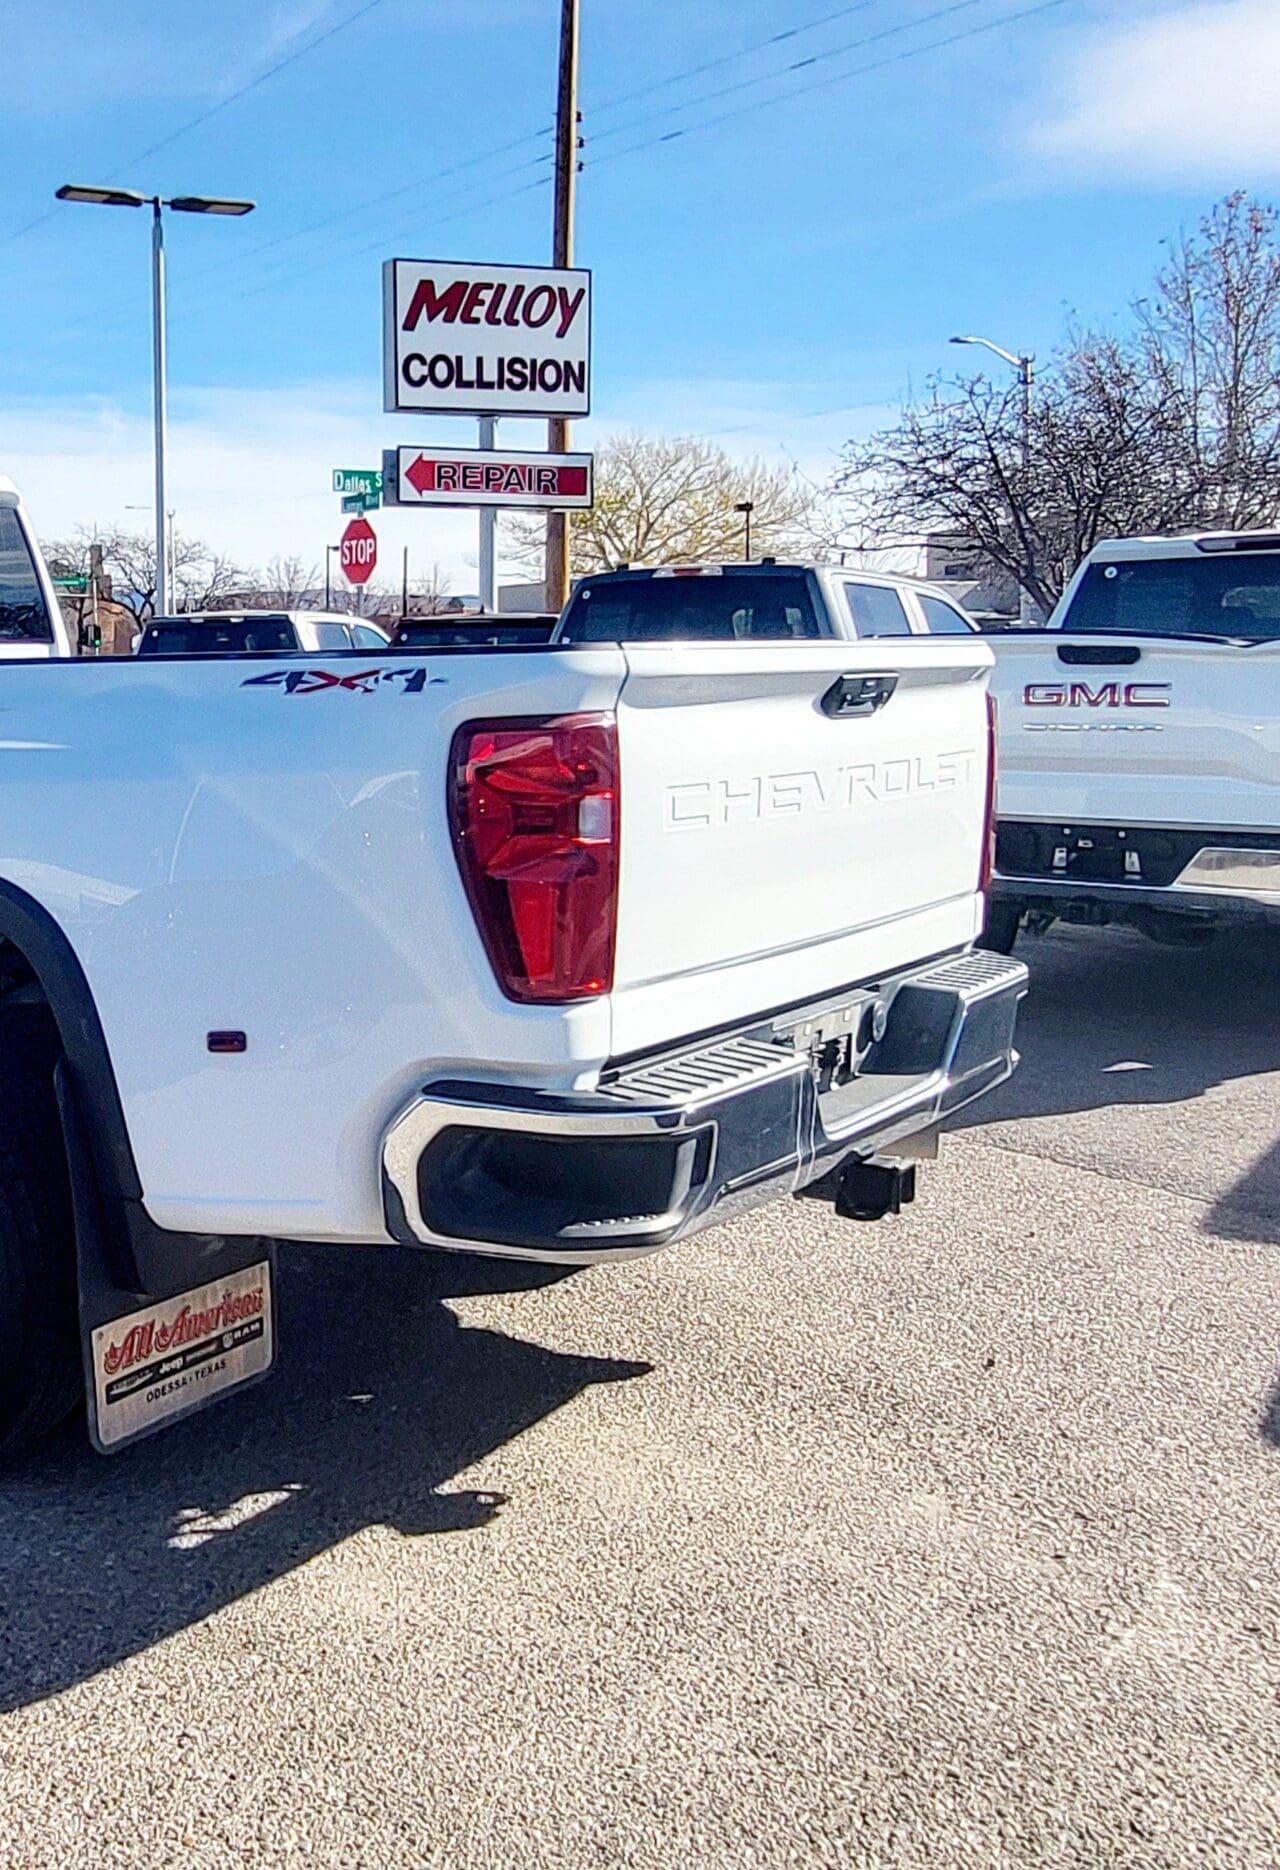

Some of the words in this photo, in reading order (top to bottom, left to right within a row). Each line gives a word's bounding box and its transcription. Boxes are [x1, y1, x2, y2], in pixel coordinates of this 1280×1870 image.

[402, 279, 586, 338] MELLOY
[402, 352, 585, 393] COLLISION
[334, 471, 372, 494] Dallas
[436, 462, 559, 494] REPAIR
[341, 541, 375, 566] STOP
[1022, 682, 1172, 708] GMC
[664, 748, 976, 832] CHEVROLET
[104, 1319, 155, 1376] All
[155, 1286, 264, 1352] American
[158, 1355, 184, 1375] Jeep
[233, 1322, 261, 1340] RAM
[146, 1377, 188, 1403] ODESSA
[194, 1359, 227, 1382] TEXAS
